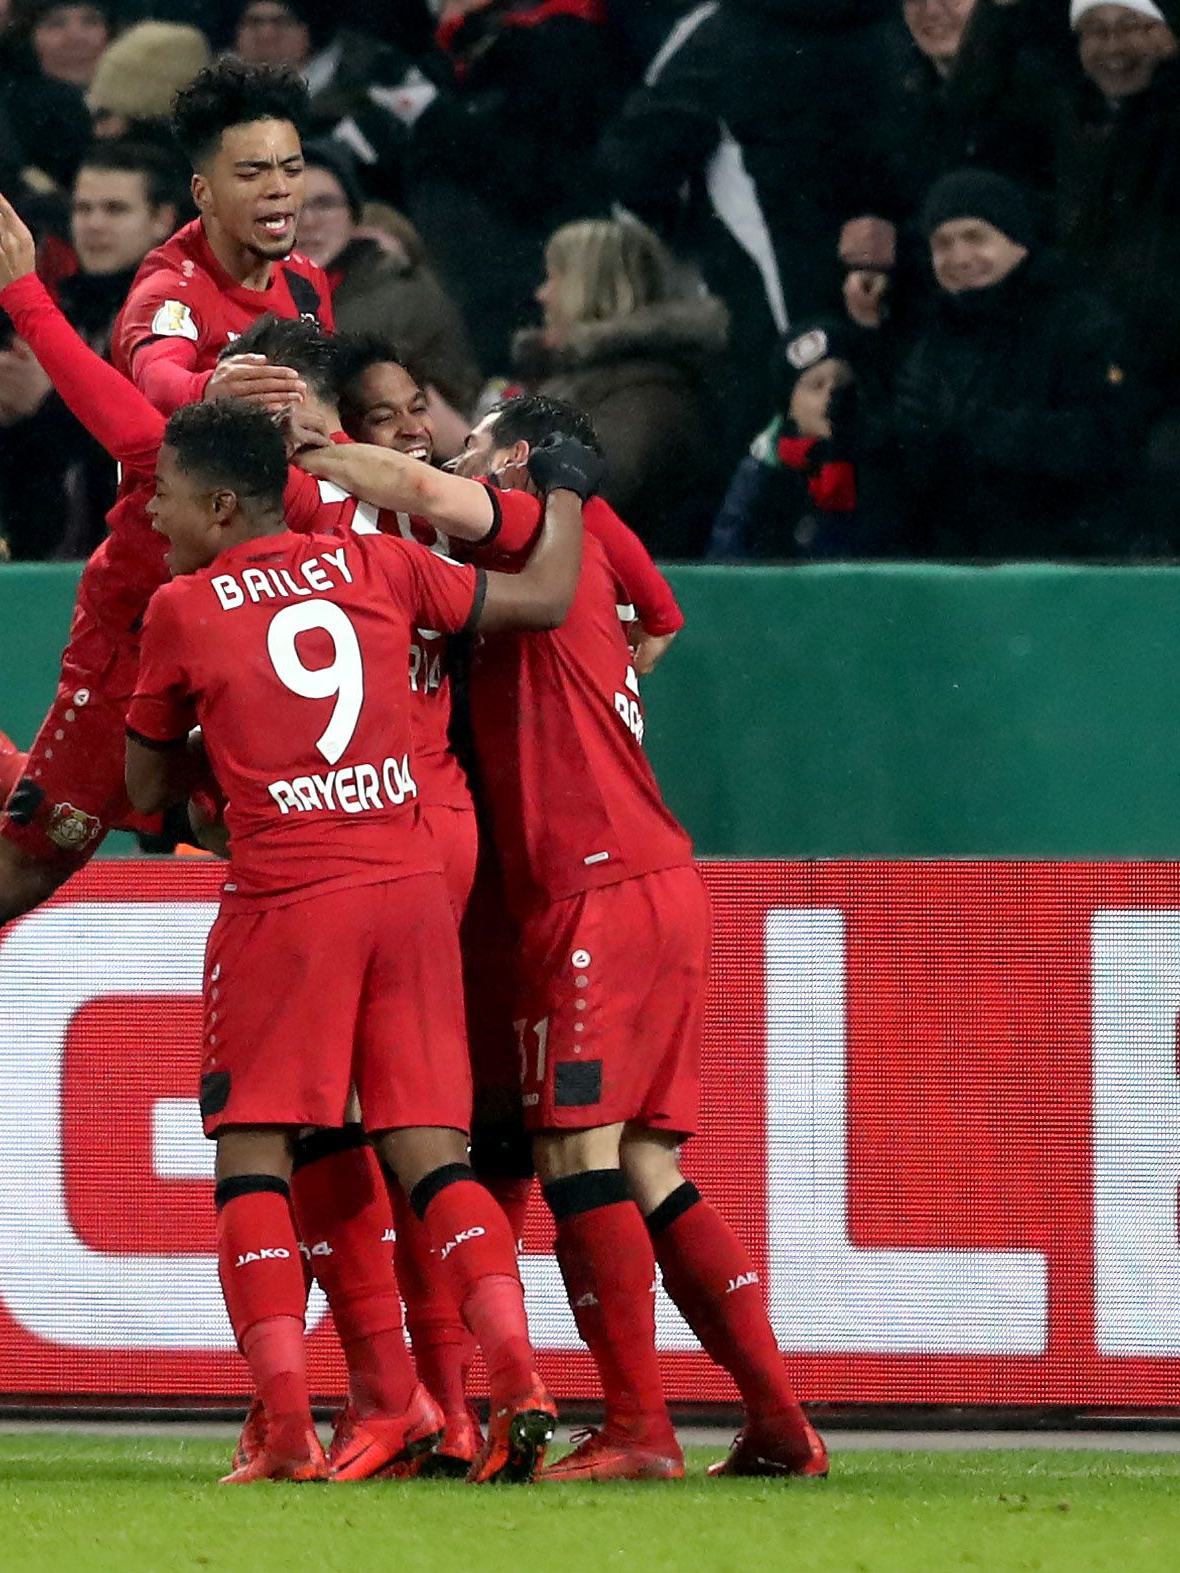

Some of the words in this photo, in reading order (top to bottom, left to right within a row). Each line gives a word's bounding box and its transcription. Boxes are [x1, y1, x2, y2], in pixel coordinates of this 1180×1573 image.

[211, 548, 352, 611] BAILEY
[267, 598, 363, 765] 9
[382, 753, 418, 804] 04
[235, 1247, 290, 1268] JAKO
[440, 1226, 485, 1260] JAKO
